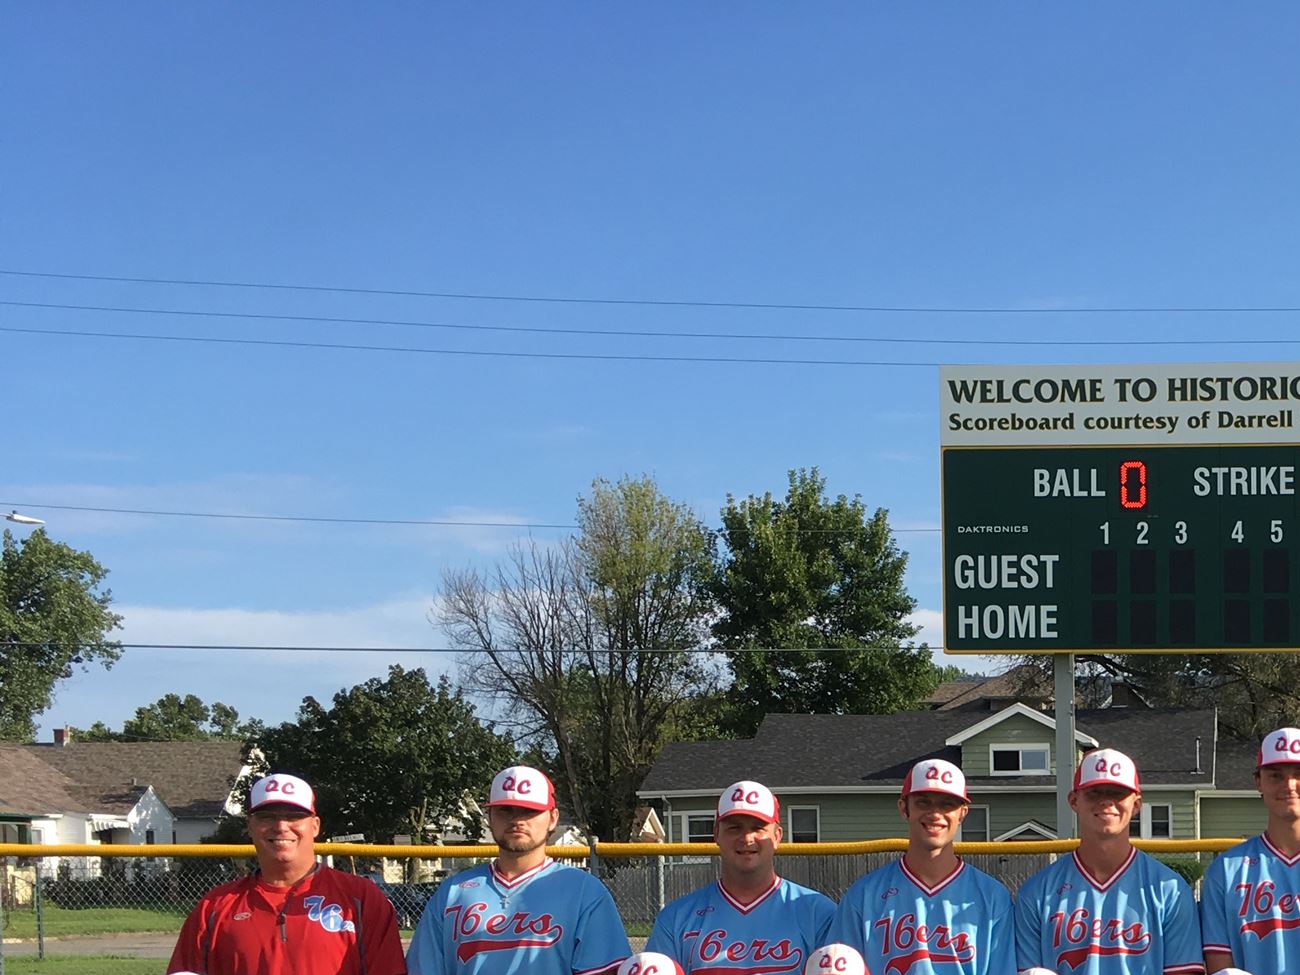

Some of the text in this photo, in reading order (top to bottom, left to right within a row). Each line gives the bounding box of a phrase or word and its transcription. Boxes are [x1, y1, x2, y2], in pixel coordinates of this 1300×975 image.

[947, 378, 1105, 403] WELCOME
[1114, 377, 1157, 402] TO
[949, 412, 1075, 431] Scoreboard
[1084, 413, 1179, 434] courtesy
[1187, 411, 1211, 430] of
[1217, 409, 1293, 429] Darrell
[1033, 468, 1106, 497] BALL
[1120, 460, 1148, 509] 0
[1193, 466, 1295, 497] STRIKE
[957, 525, 1029, 533] DAKTRONICS
[1100, 521, 1111, 545] 1
[1136, 521, 1149, 545] 2
[1175, 520, 1188, 545] 3
[1231, 520, 1245, 543] 4
[1270, 519, 1283, 543] 5
[954, 554, 1060, 589] GUEST
[958, 604, 1058, 639] HOME
[443, 901, 563, 942] 76ers
[874, 913, 975, 957] 76ers
[1048, 908, 1151, 949] 76ers
